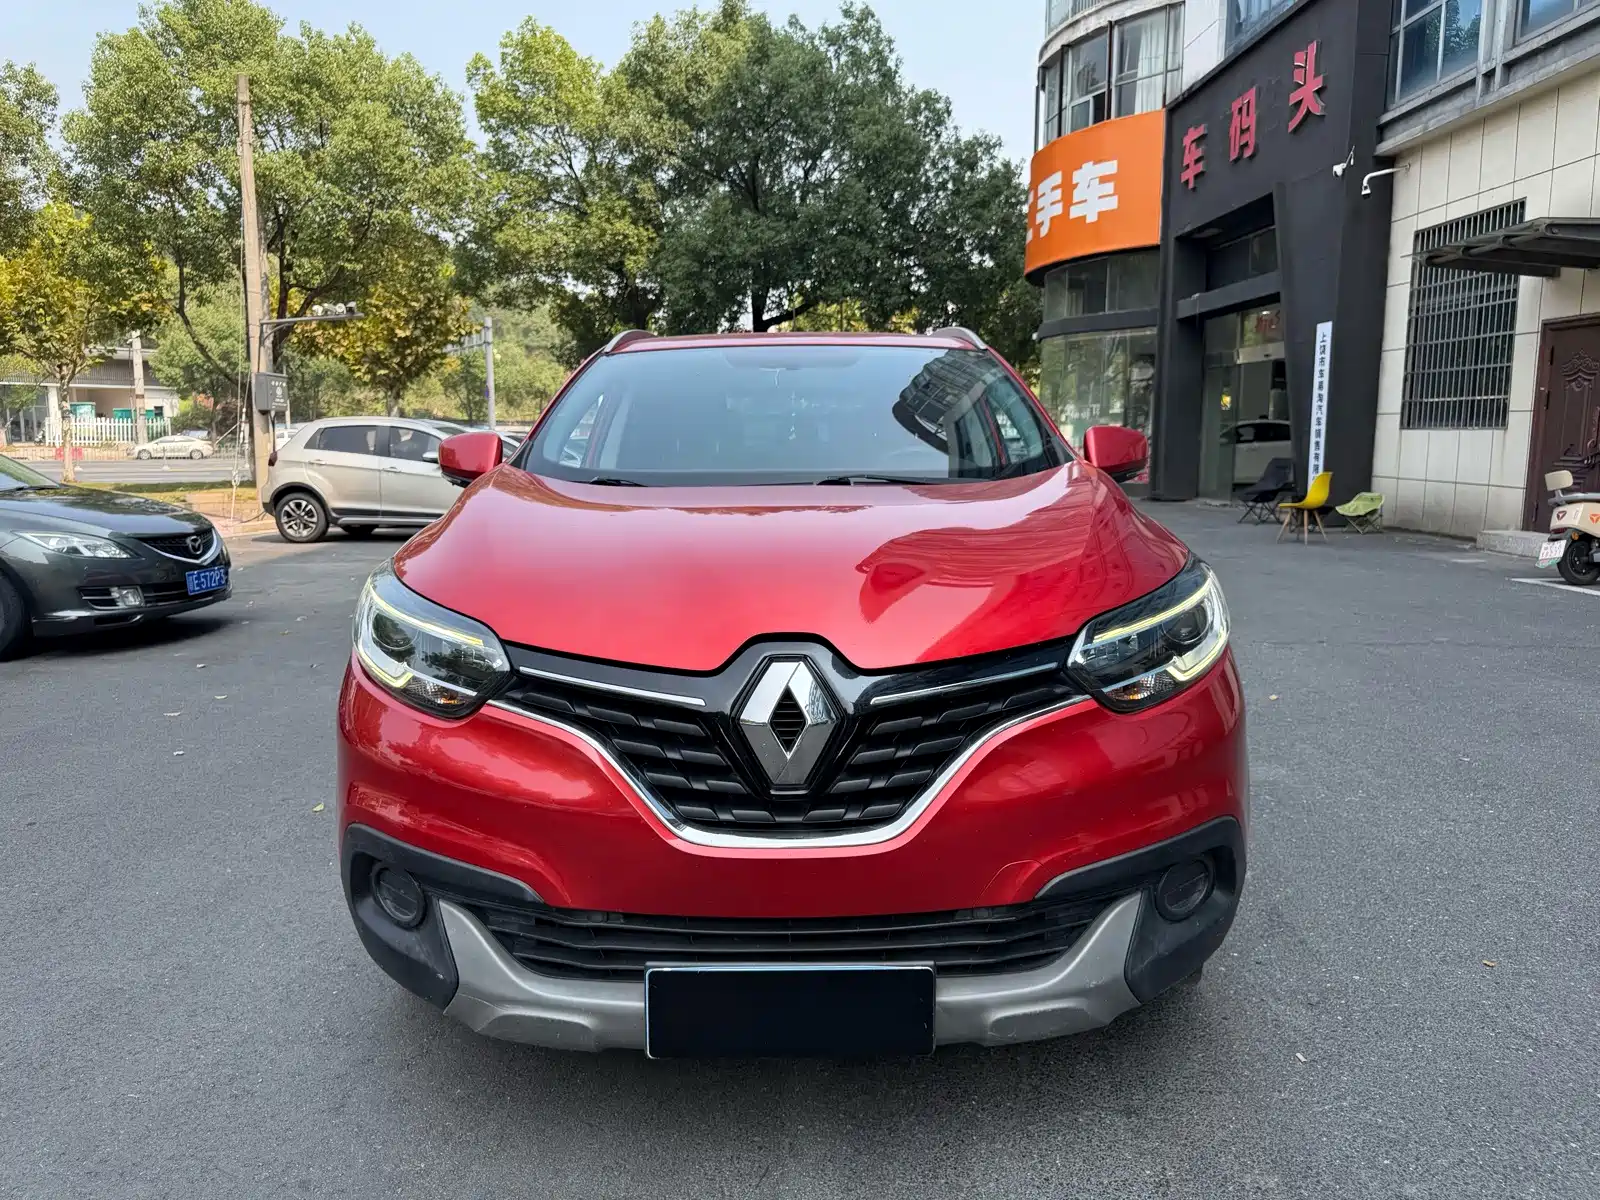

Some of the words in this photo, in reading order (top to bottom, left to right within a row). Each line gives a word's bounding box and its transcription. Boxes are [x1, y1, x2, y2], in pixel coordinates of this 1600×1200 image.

[1181, 40, 1327, 190] 车码头
[1026, 160, 1118, 244] 手车
[1312, 332, 1327, 481] 上饶市车易淘汽车销售有限
